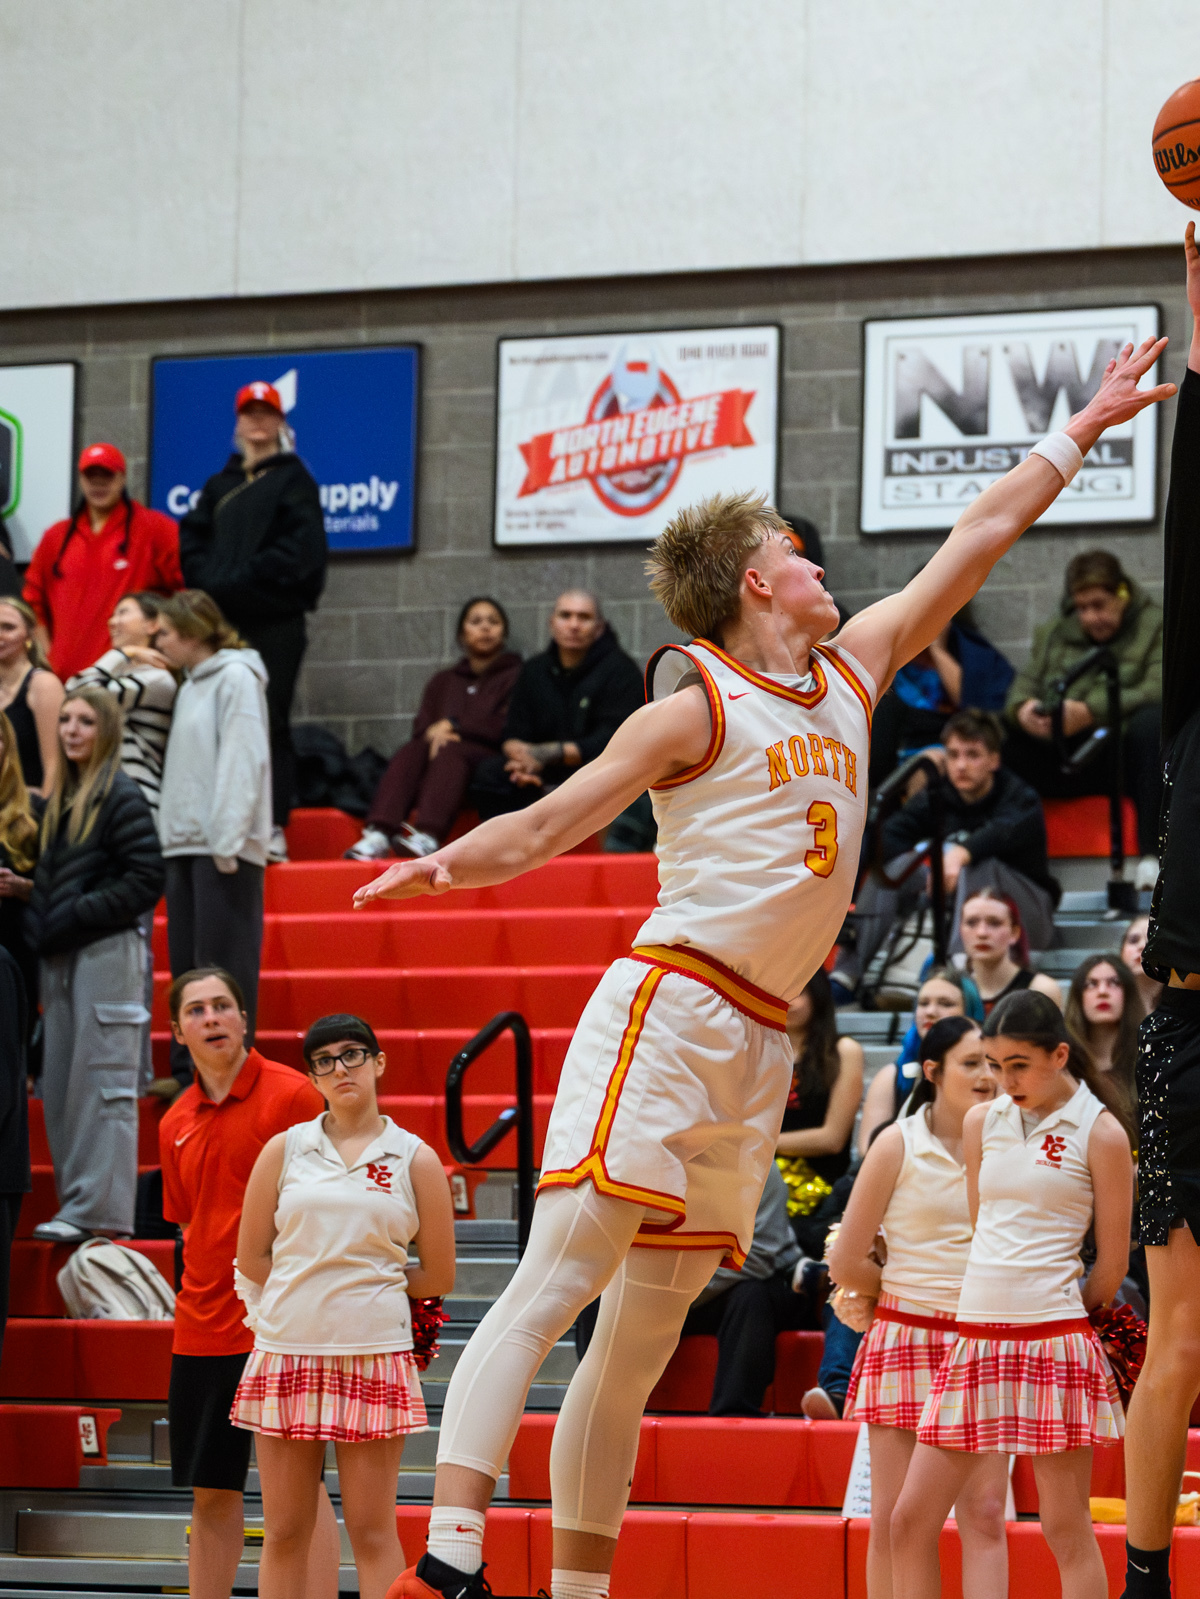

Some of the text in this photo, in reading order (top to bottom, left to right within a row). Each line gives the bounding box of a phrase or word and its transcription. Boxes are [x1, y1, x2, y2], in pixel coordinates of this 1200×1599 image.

[894, 339, 1124, 439] NW
[549, 422, 717, 484] AUTOMOTIVE
[550, 394, 722, 460] NORTH EUGENE
[765, 733, 857, 798] NORTH
[804, 800, 839, 879] 3
